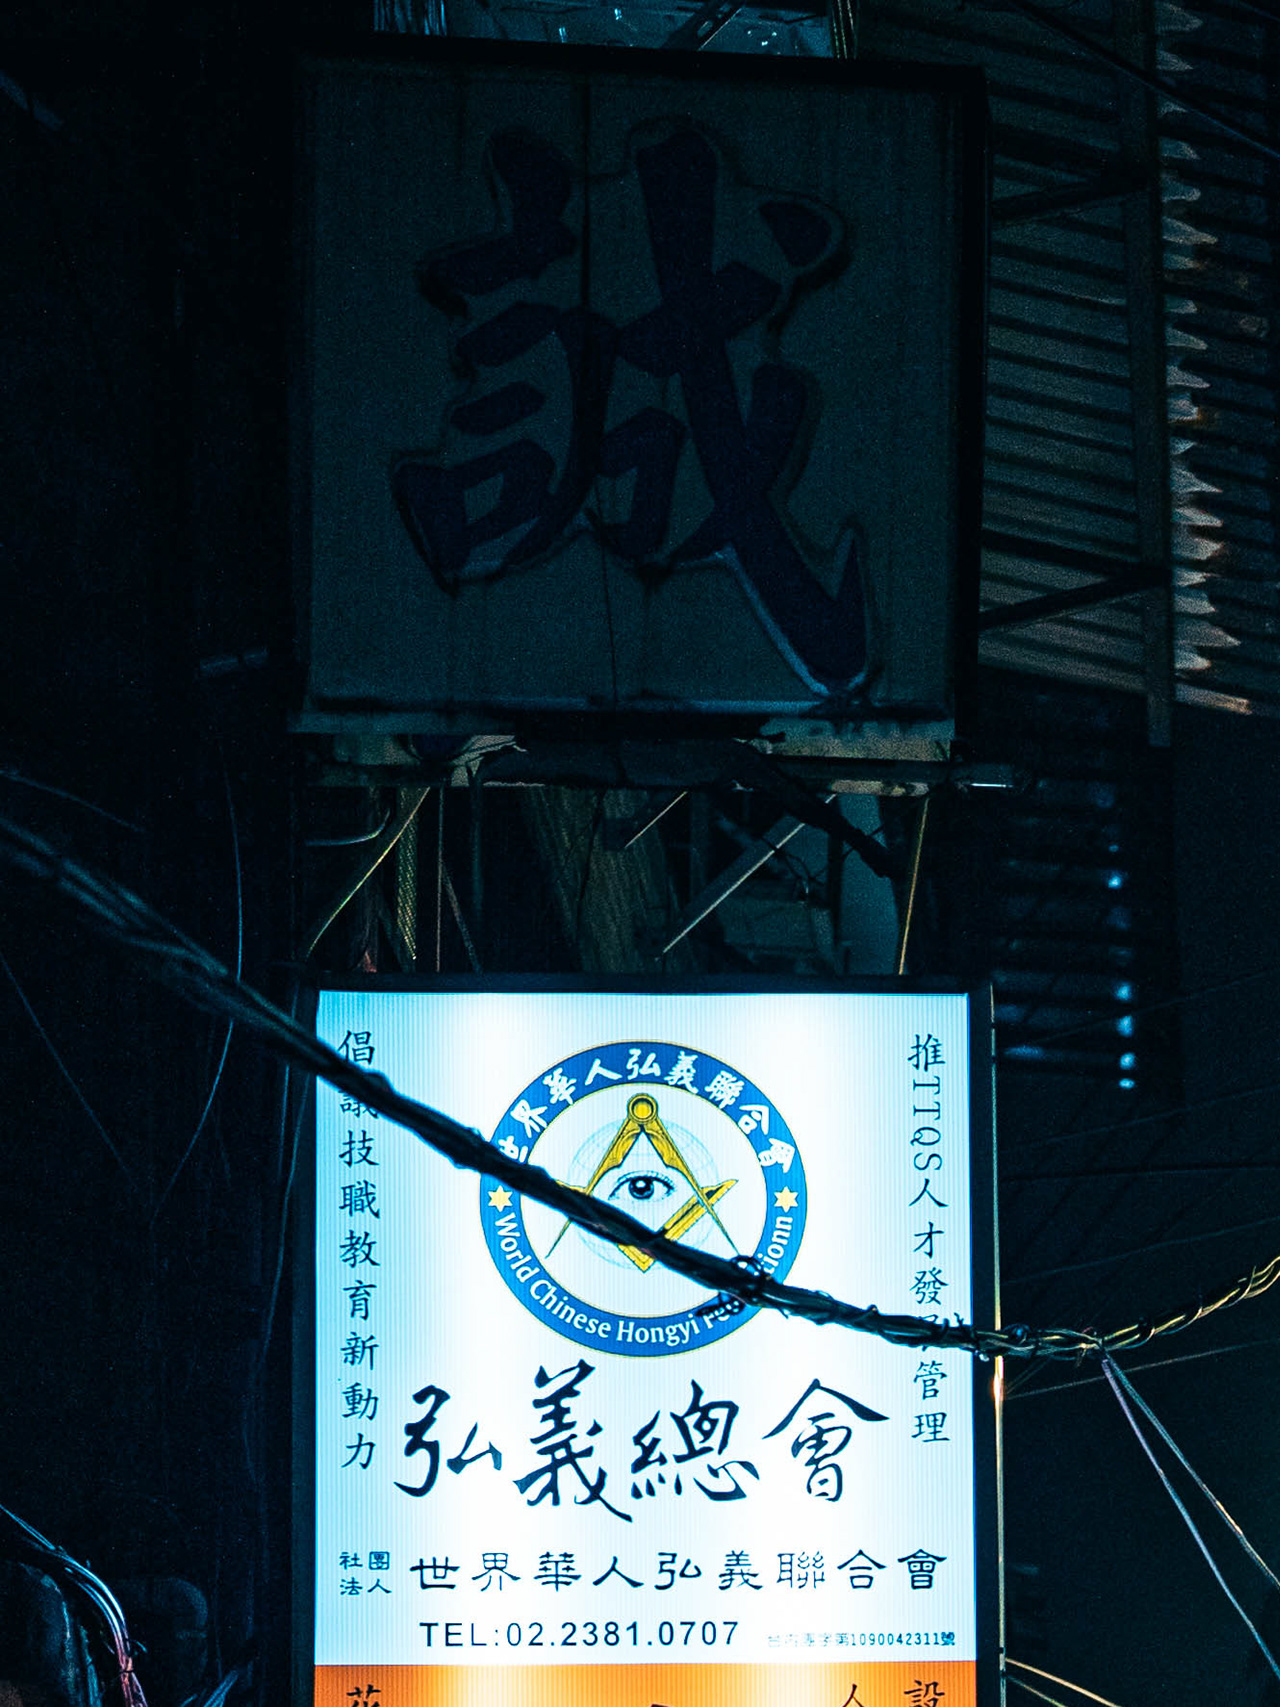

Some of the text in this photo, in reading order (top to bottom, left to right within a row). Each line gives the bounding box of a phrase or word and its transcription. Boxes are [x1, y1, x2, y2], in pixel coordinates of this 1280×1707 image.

[391, 112, 876, 696] 誠
[494, 1212, 528, 1284] World
[529, 1278, 613, 1339] Chinese
[616, 1312, 701, 1347] Hongyi
[907, 1031, 951, 1446] 推TTQS人才發管理
[393, 1358, 891, 1523] 弘義總會
[409, 1547, 949, 1591] 世界華人弘義聯合會
[420, 1620, 740, 1648] TEL:02.2381.0707
